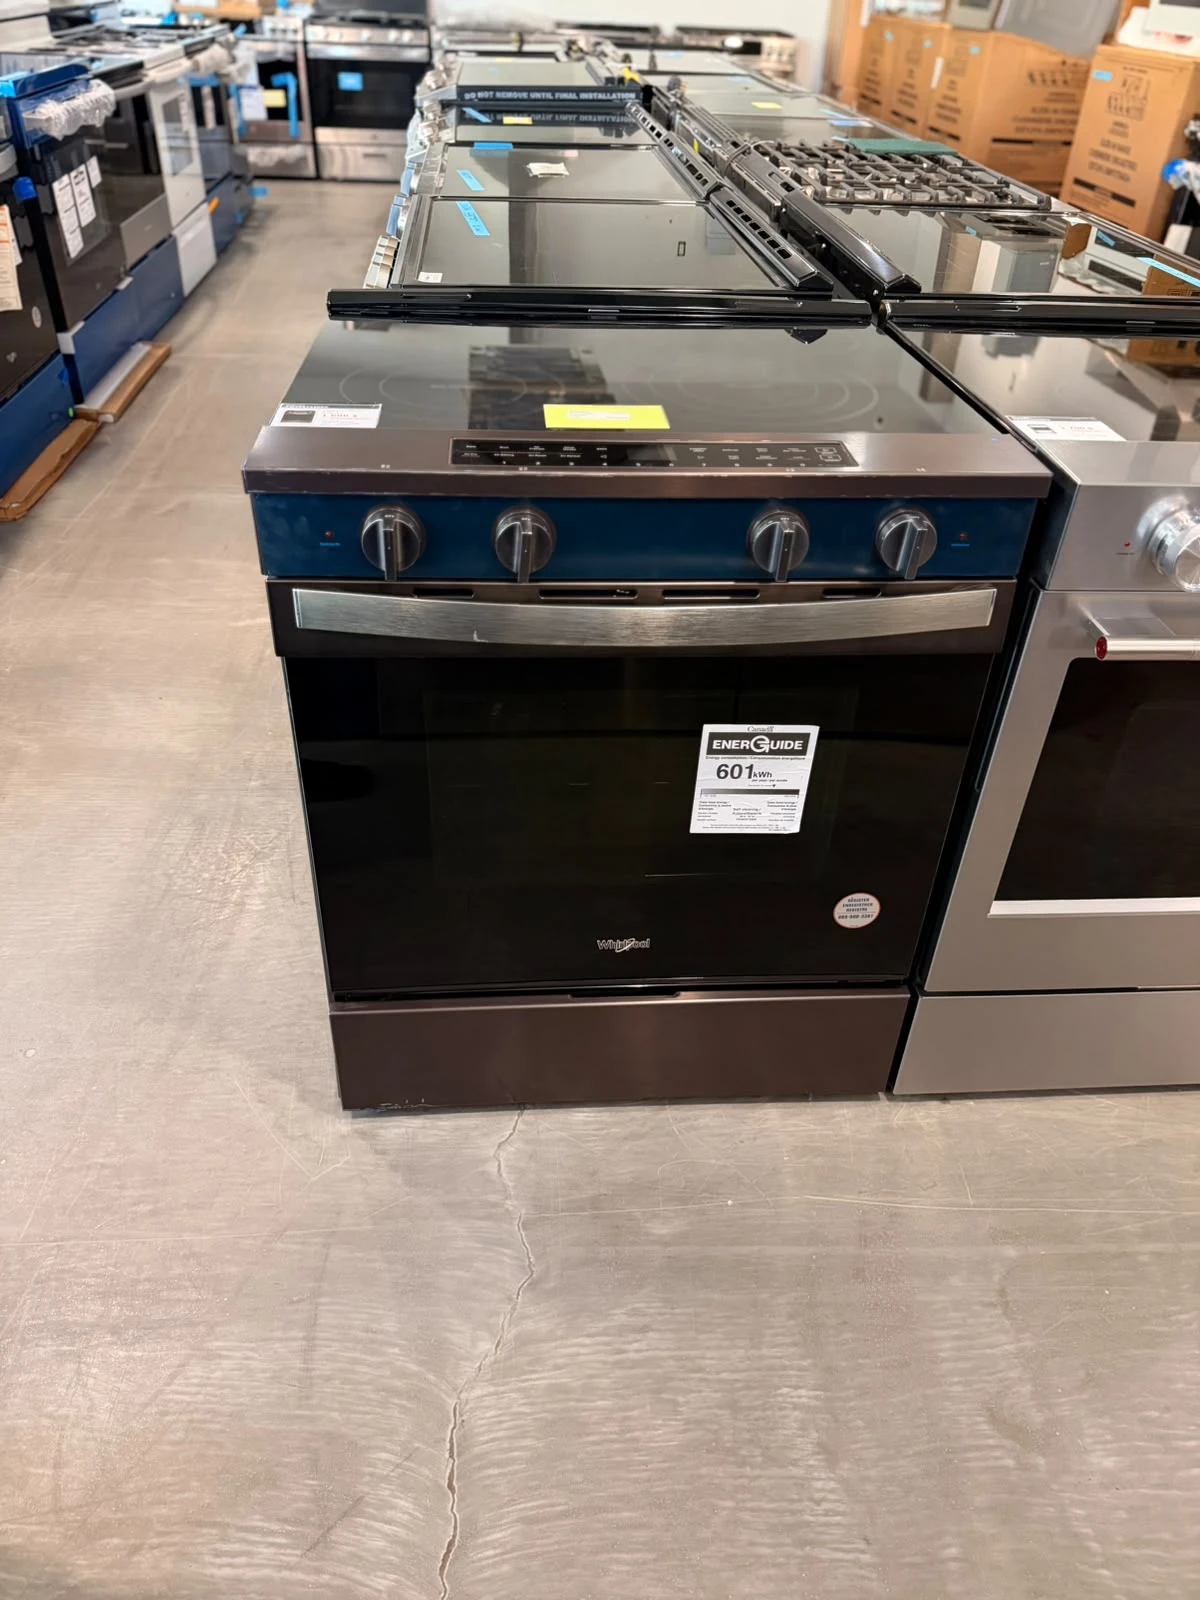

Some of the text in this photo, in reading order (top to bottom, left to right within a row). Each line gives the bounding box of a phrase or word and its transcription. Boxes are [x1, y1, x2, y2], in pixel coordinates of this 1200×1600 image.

[464, 92, 476, 100] DO
[477, 91, 494, 99] NOT
[495, 91, 528, 99] REMOVE
[579, 92, 637, 100] INSTALLATION
[712, 735, 804, 753] ENERGUIDE
[716, 763, 754, 780] 601
[596, 937, 651, 953] Whirlpool
